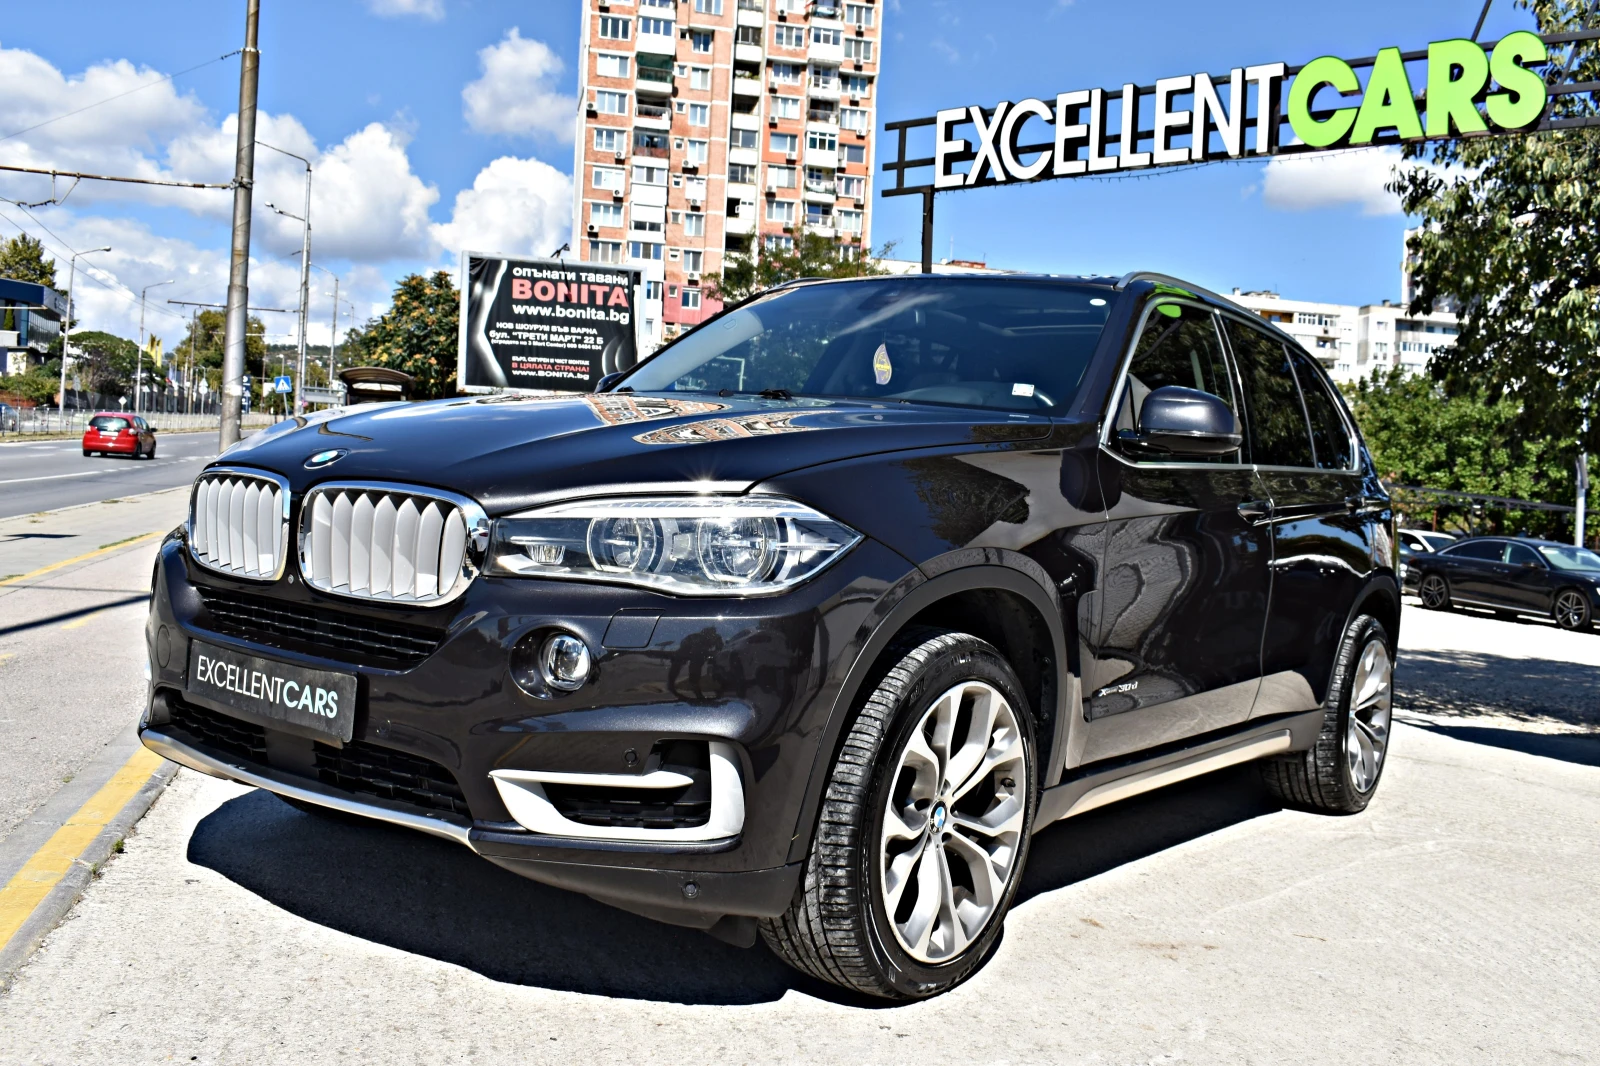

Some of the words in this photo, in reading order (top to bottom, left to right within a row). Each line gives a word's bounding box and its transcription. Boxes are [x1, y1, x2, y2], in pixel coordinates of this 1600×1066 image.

[512, 266, 576, 281] опънати
[580, 272, 629, 286] тавани
[511, 278, 629, 308] BONITA
[512, 304, 630, 325] www.bonita.bg
[496, 321, 514, 329] НОВ
[515, 323, 550, 332] ШОУРУМ
[551, 325, 569, 333] ВЪВ
[571, 326, 598, 335] ВАРНА
[489, 330, 510, 340] бул.
[583, 336, 594, 344] 22
[512, 370, 590, 380] www.BONITA.bg
[520, 362, 553, 371] ЦЯЛАТА
[554, 364, 590, 372] СТРАНА!
[197, 655, 338, 719] EXCELLENTCARS
